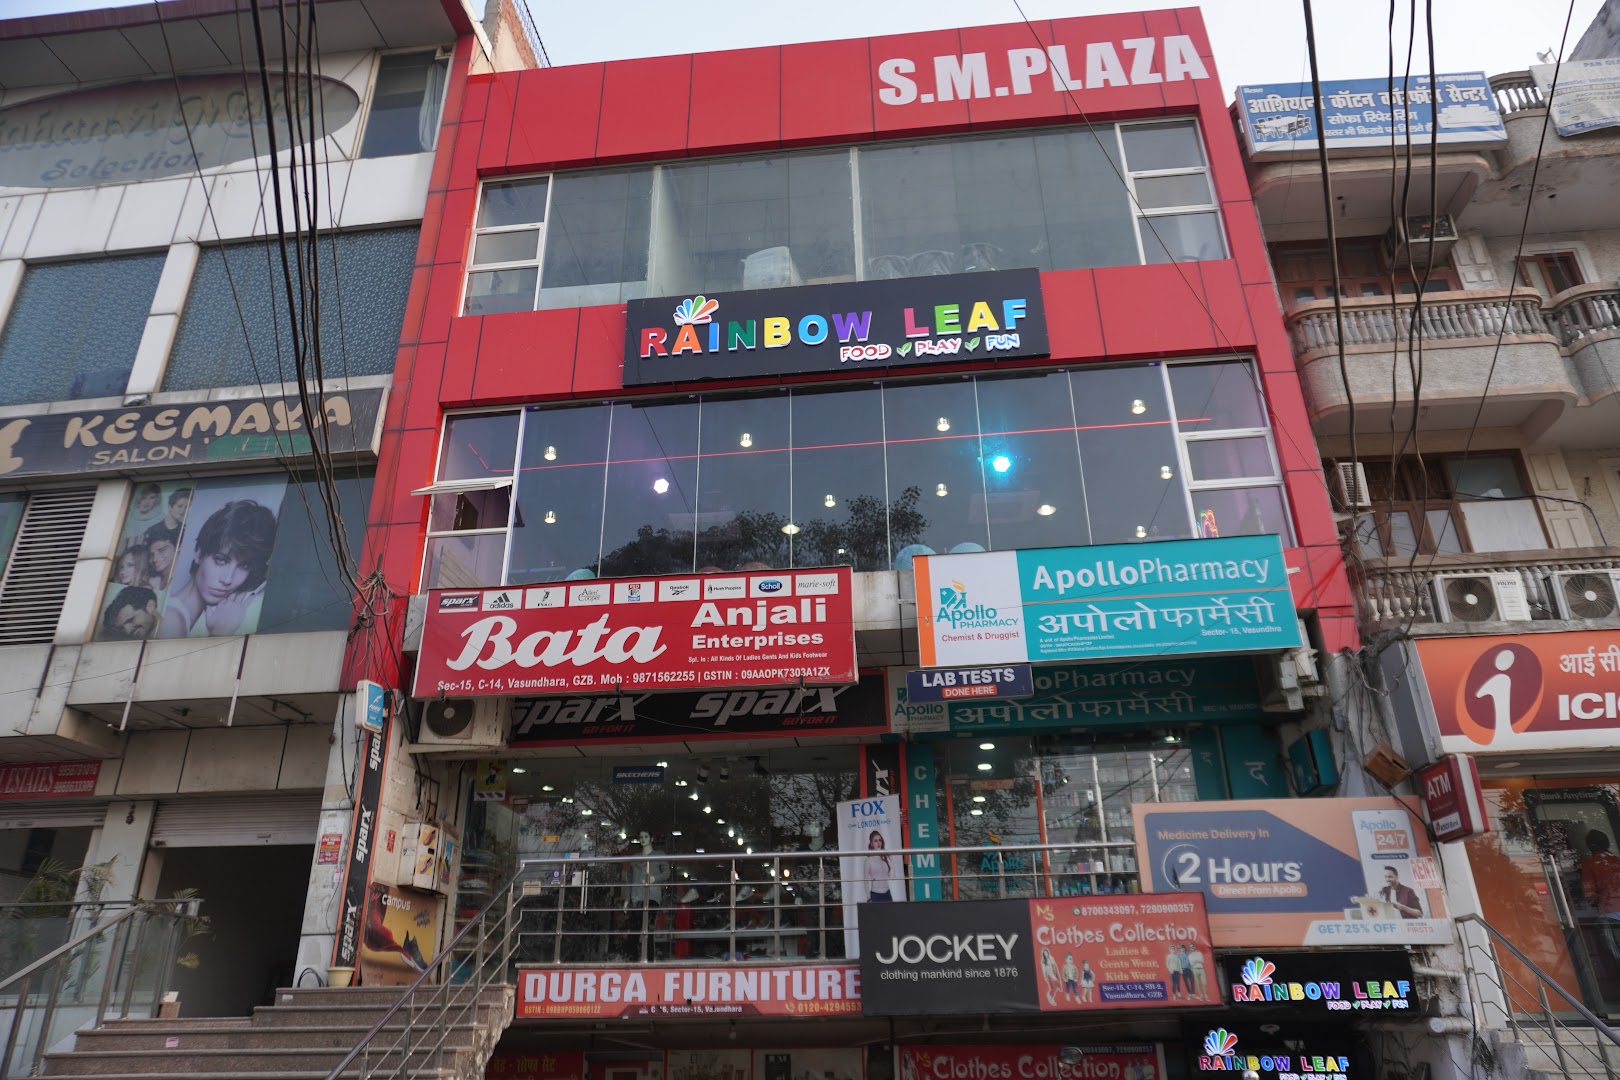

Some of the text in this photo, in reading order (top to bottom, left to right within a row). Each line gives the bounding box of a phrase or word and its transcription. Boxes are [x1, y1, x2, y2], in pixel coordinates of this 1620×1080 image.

[878, 34, 1210, 106] S.M.PLAZA
[40, 152, 204, 181] Selection
[639, 298, 1027, 359] RAINBOW LEAF
[840, 333, 1020, 363] FOOD PLAY FUN
[63, 396, 352, 448] KEEMAYA
[91, 444, 191, 466] SALON
[760, 581, 781, 591] Scholl
[798, 578, 836, 590] marie-soft
[690, 597, 827, 632] Anjali
[936, 604, 997, 629] Apollo
[959, 618, 1019, 629] PHARMACY
[1038, 595, 1276, 635] अपोलो फार्मेसी
[692, 631, 824, 651] Enterprises
[941, 631, 1020, 642] Chemist & Druggist
[1201, 626, 1282, 637] Sector- 15, Vasundhra
[446, 613, 667, 671] Bata
[743, 653, 761, 661] Ladies
[1559, 646, 1596, 677] आई
[438, 679, 475, 692] Sec-15,
[478, 678, 504, 690] C-14,
[507, 676, 570, 689] Vasundhara,
[573, 675, 597, 686] GZB.
[600, 674, 623, 685] Mob
[632, 670, 695, 684] 9871562255
[703, 670, 732, 681] GSTIN
[922, 668, 1015, 688] LAB TESTS
[945, 686, 995, 697] DONE HERE
[690, 687, 852, 726] sparx
[895, 702, 944, 722] Apollo
[954, 697, 1074, 725] अपोलो
[1558, 692, 1620, 722] ICI
[615, 770, 662, 780] SKECHERS
[1427, 772, 1451, 800] ATM
[851, 800, 885, 818] FOX
[857, 819, 881, 829] LONDON
[1158, 828, 1270, 840] Medicine Delivery In
[1360, 820, 1397, 834] Apollo
[1178, 852, 1201, 884] 2
[1219, 885, 1302, 896] Direct From Apollo
[381, 892, 411, 912] campus
[1036, 921, 1198, 948] Clothes Collection
[1318, 923, 1397, 934] GET 25% OFF
[875, 933, 1019, 965] JOCKEY
[1105, 946, 1150, 957] Ladies &
[880, 966, 1018, 981] clothing mankind since 1876
[1100, 958, 1159, 969] Gents Wear,
[1105, 970, 1158, 981] Kids Wear
[524, 969, 861, 1003] DURGA FURNITURE
[1232, 980, 1410, 1001] RAINBOW LEAF
[670, 1005, 703, 1014] Sector-15,
[1327, 1001, 1351, 1011] FOOD
[932, 1056, 1012, 1080] Clothes
[1199, 1056, 1350, 1071] RAINBOW LEAF
